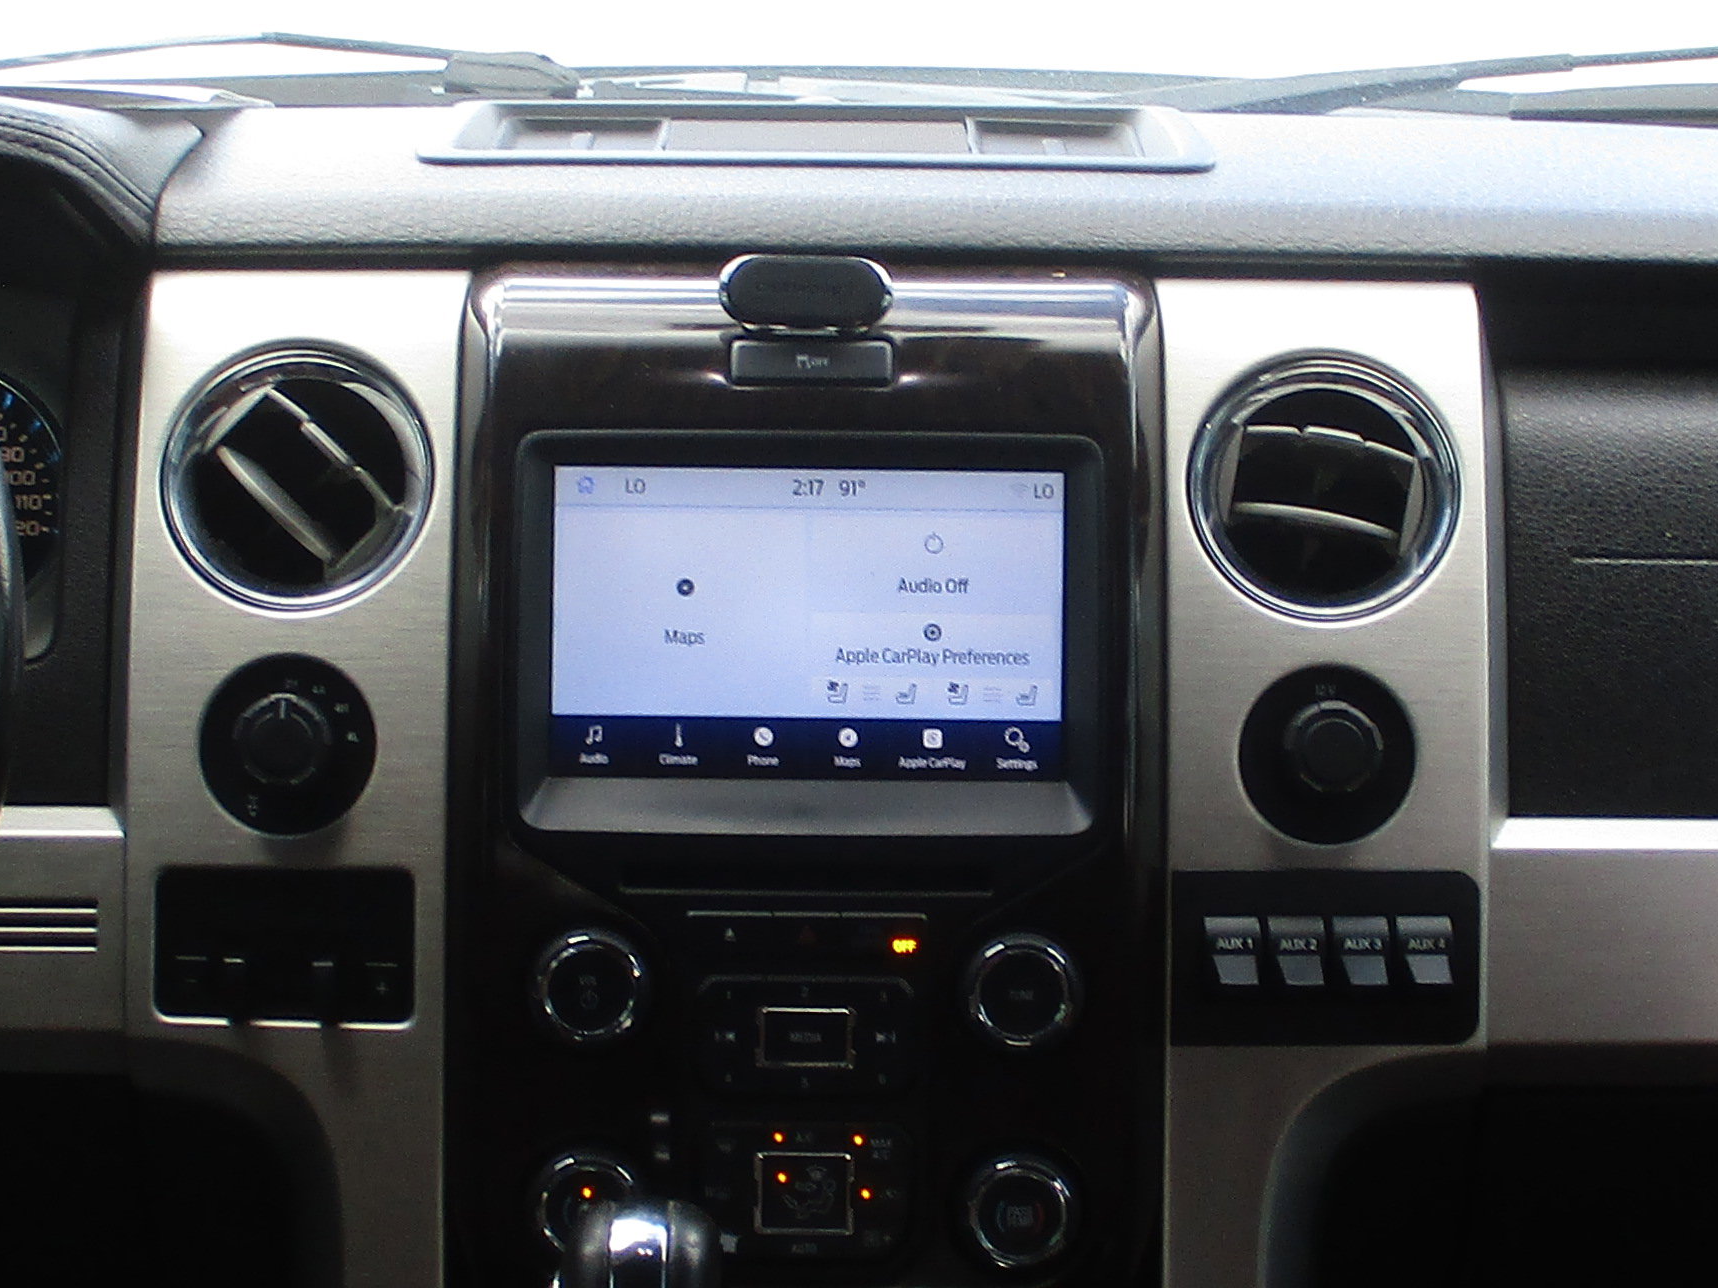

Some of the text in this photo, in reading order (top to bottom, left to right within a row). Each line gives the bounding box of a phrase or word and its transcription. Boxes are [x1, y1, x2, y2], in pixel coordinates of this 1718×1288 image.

[6, 470, 36, 487] 00
[625, 478, 646, 495] LO
[792, 479, 866, 497] 2:17 91°
[1033, 483, 1054, 500] LO
[897, 577, 969, 595] Audio Off
[664, 629, 705, 648] Maps
[835, 647, 1030, 667] Apple CarPlay Preferences
[659, 753, 698, 766] Climate
[747, 753, 779, 767] Phone
[833, 754, 861, 769] Maps
[897, 755, 966, 771] Apple CarPlay
[996, 757, 1038, 771] Settings
[891, 938, 919, 954] OFF
[1215, 937, 1245, 950] AUX
[1279, 938, 1319, 951] AUX 2
[1343, 937, 1372, 950] AUX
[1407, 937, 1437, 950] AUX
